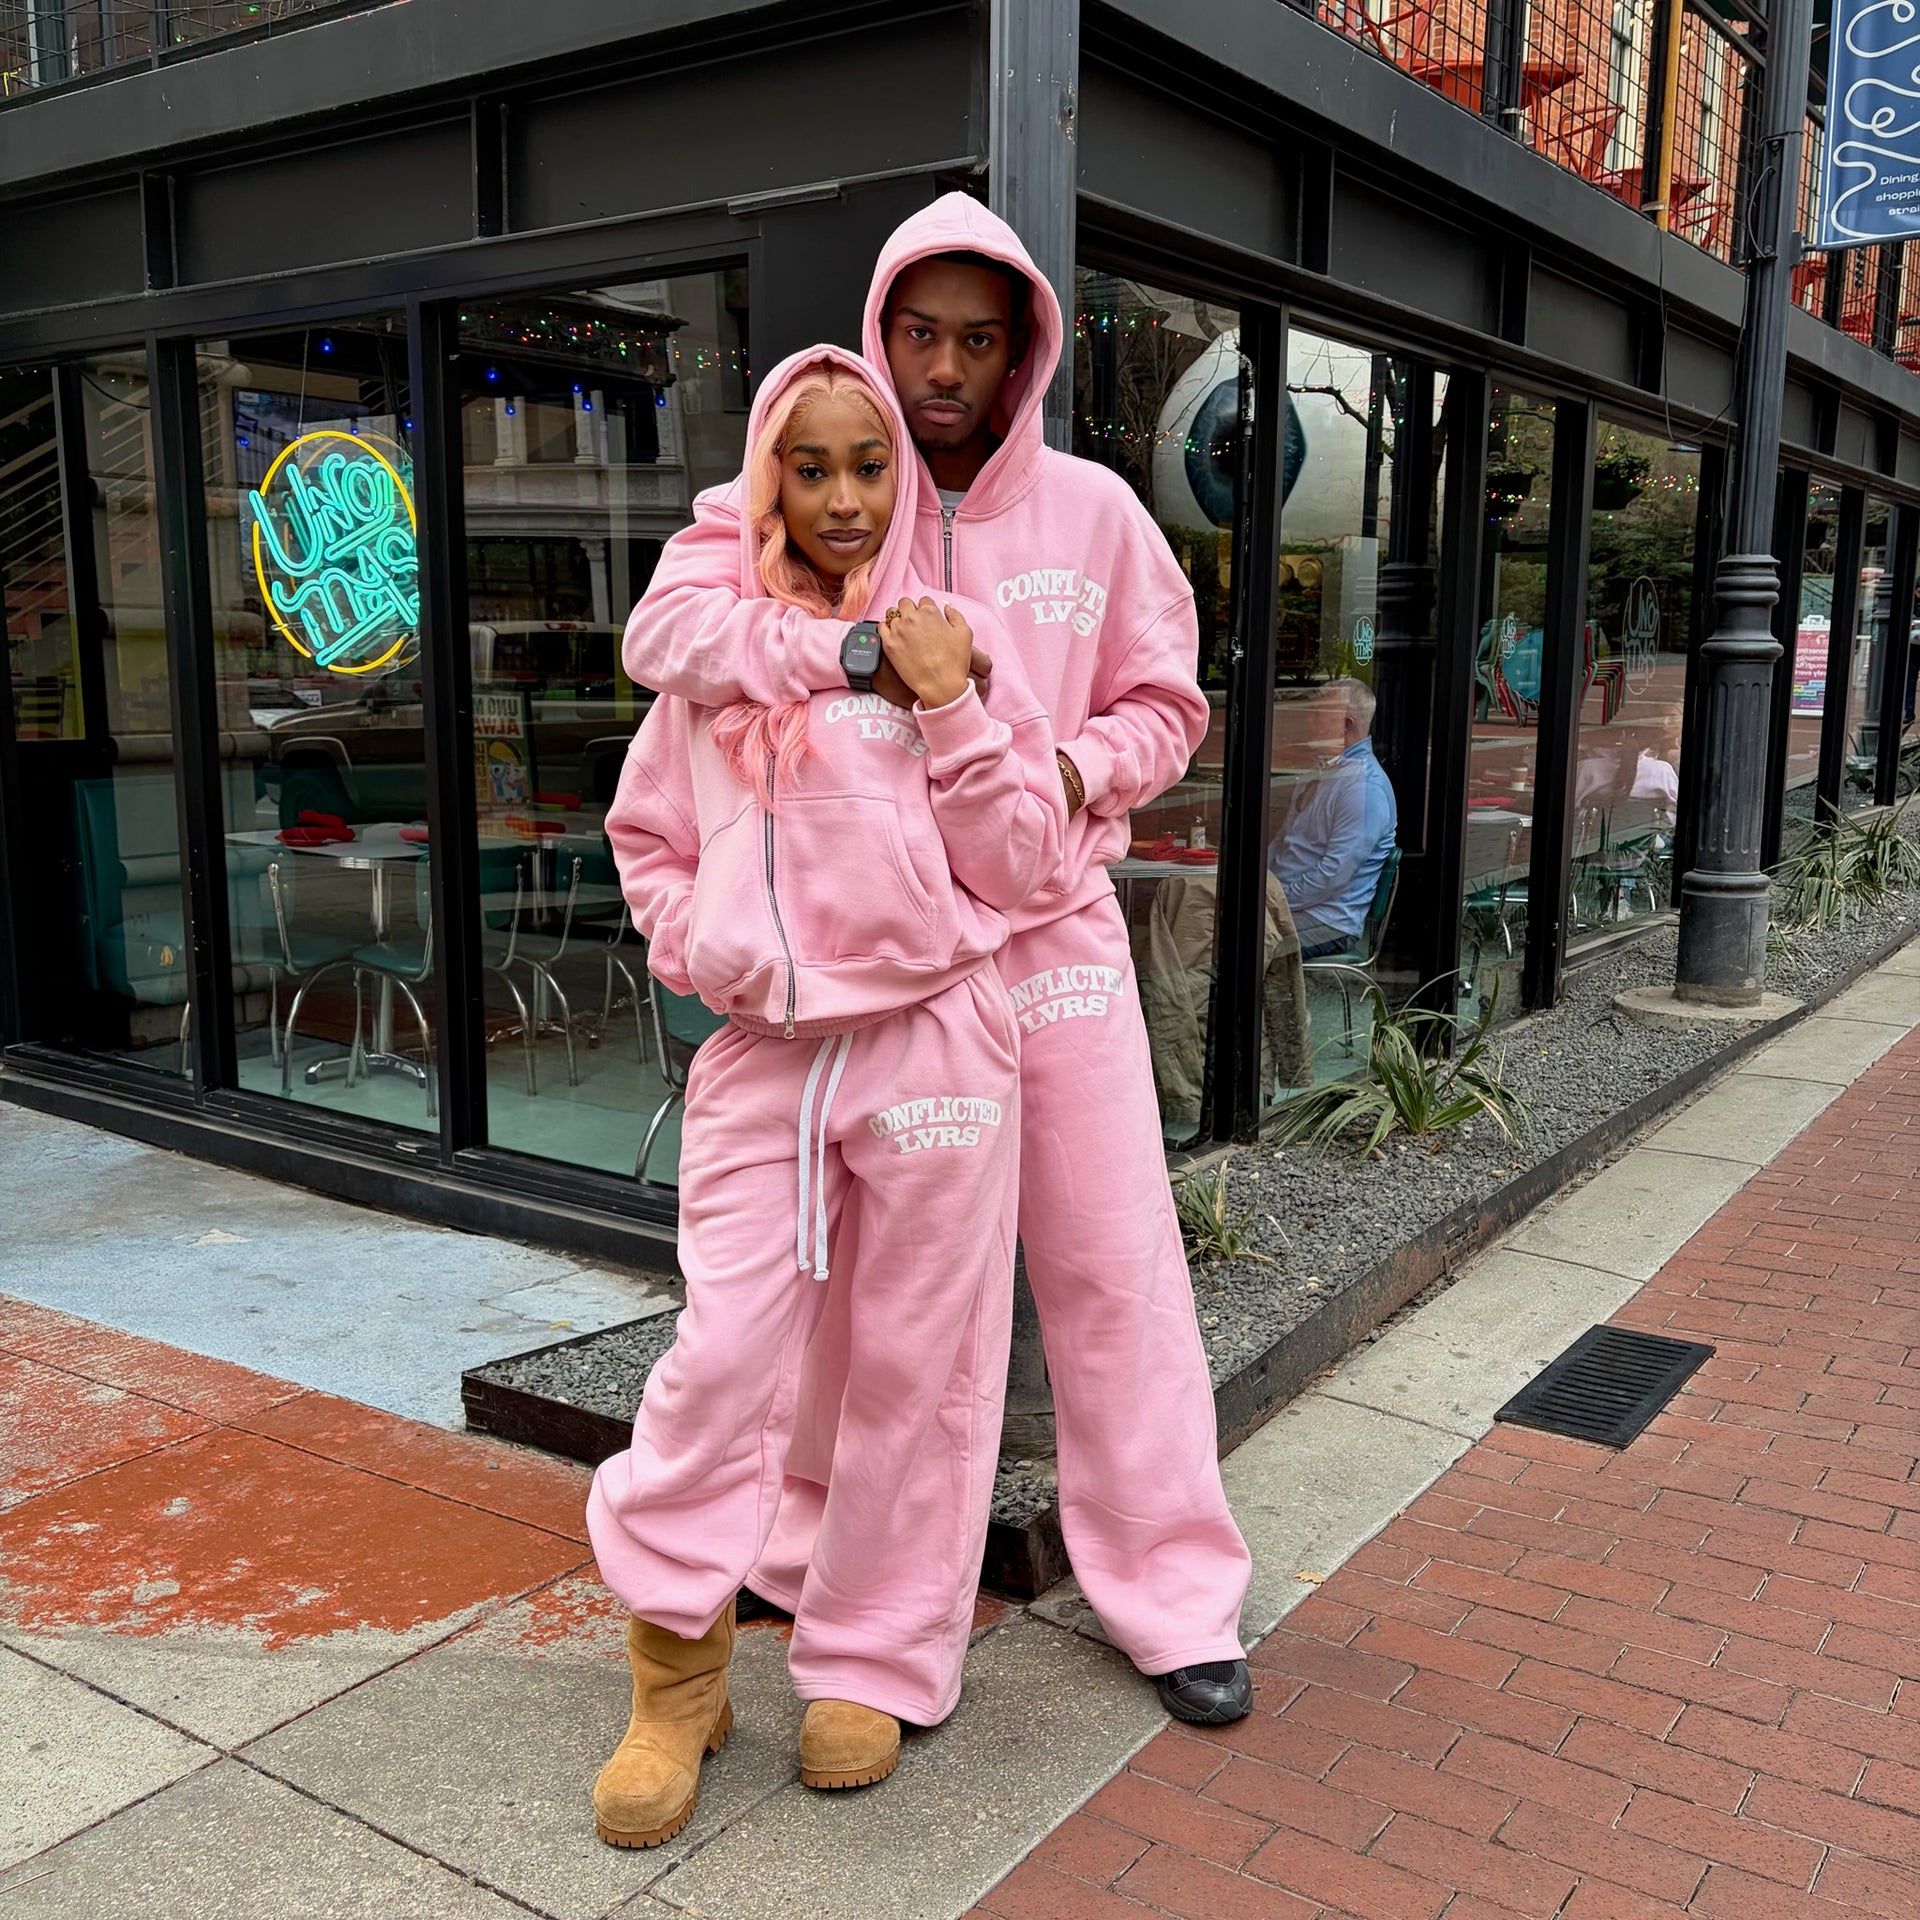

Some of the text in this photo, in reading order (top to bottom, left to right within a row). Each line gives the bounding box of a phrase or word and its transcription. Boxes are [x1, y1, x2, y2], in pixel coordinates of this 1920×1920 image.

[1030, 600, 1097, 637] LVS
[858, 719, 929, 757] LVRS
[1019, 995, 1108, 1034] LVRS
[868, 1097, 1001, 1138] CONFLICTED
[894, 1126, 980, 1155] LVRS
